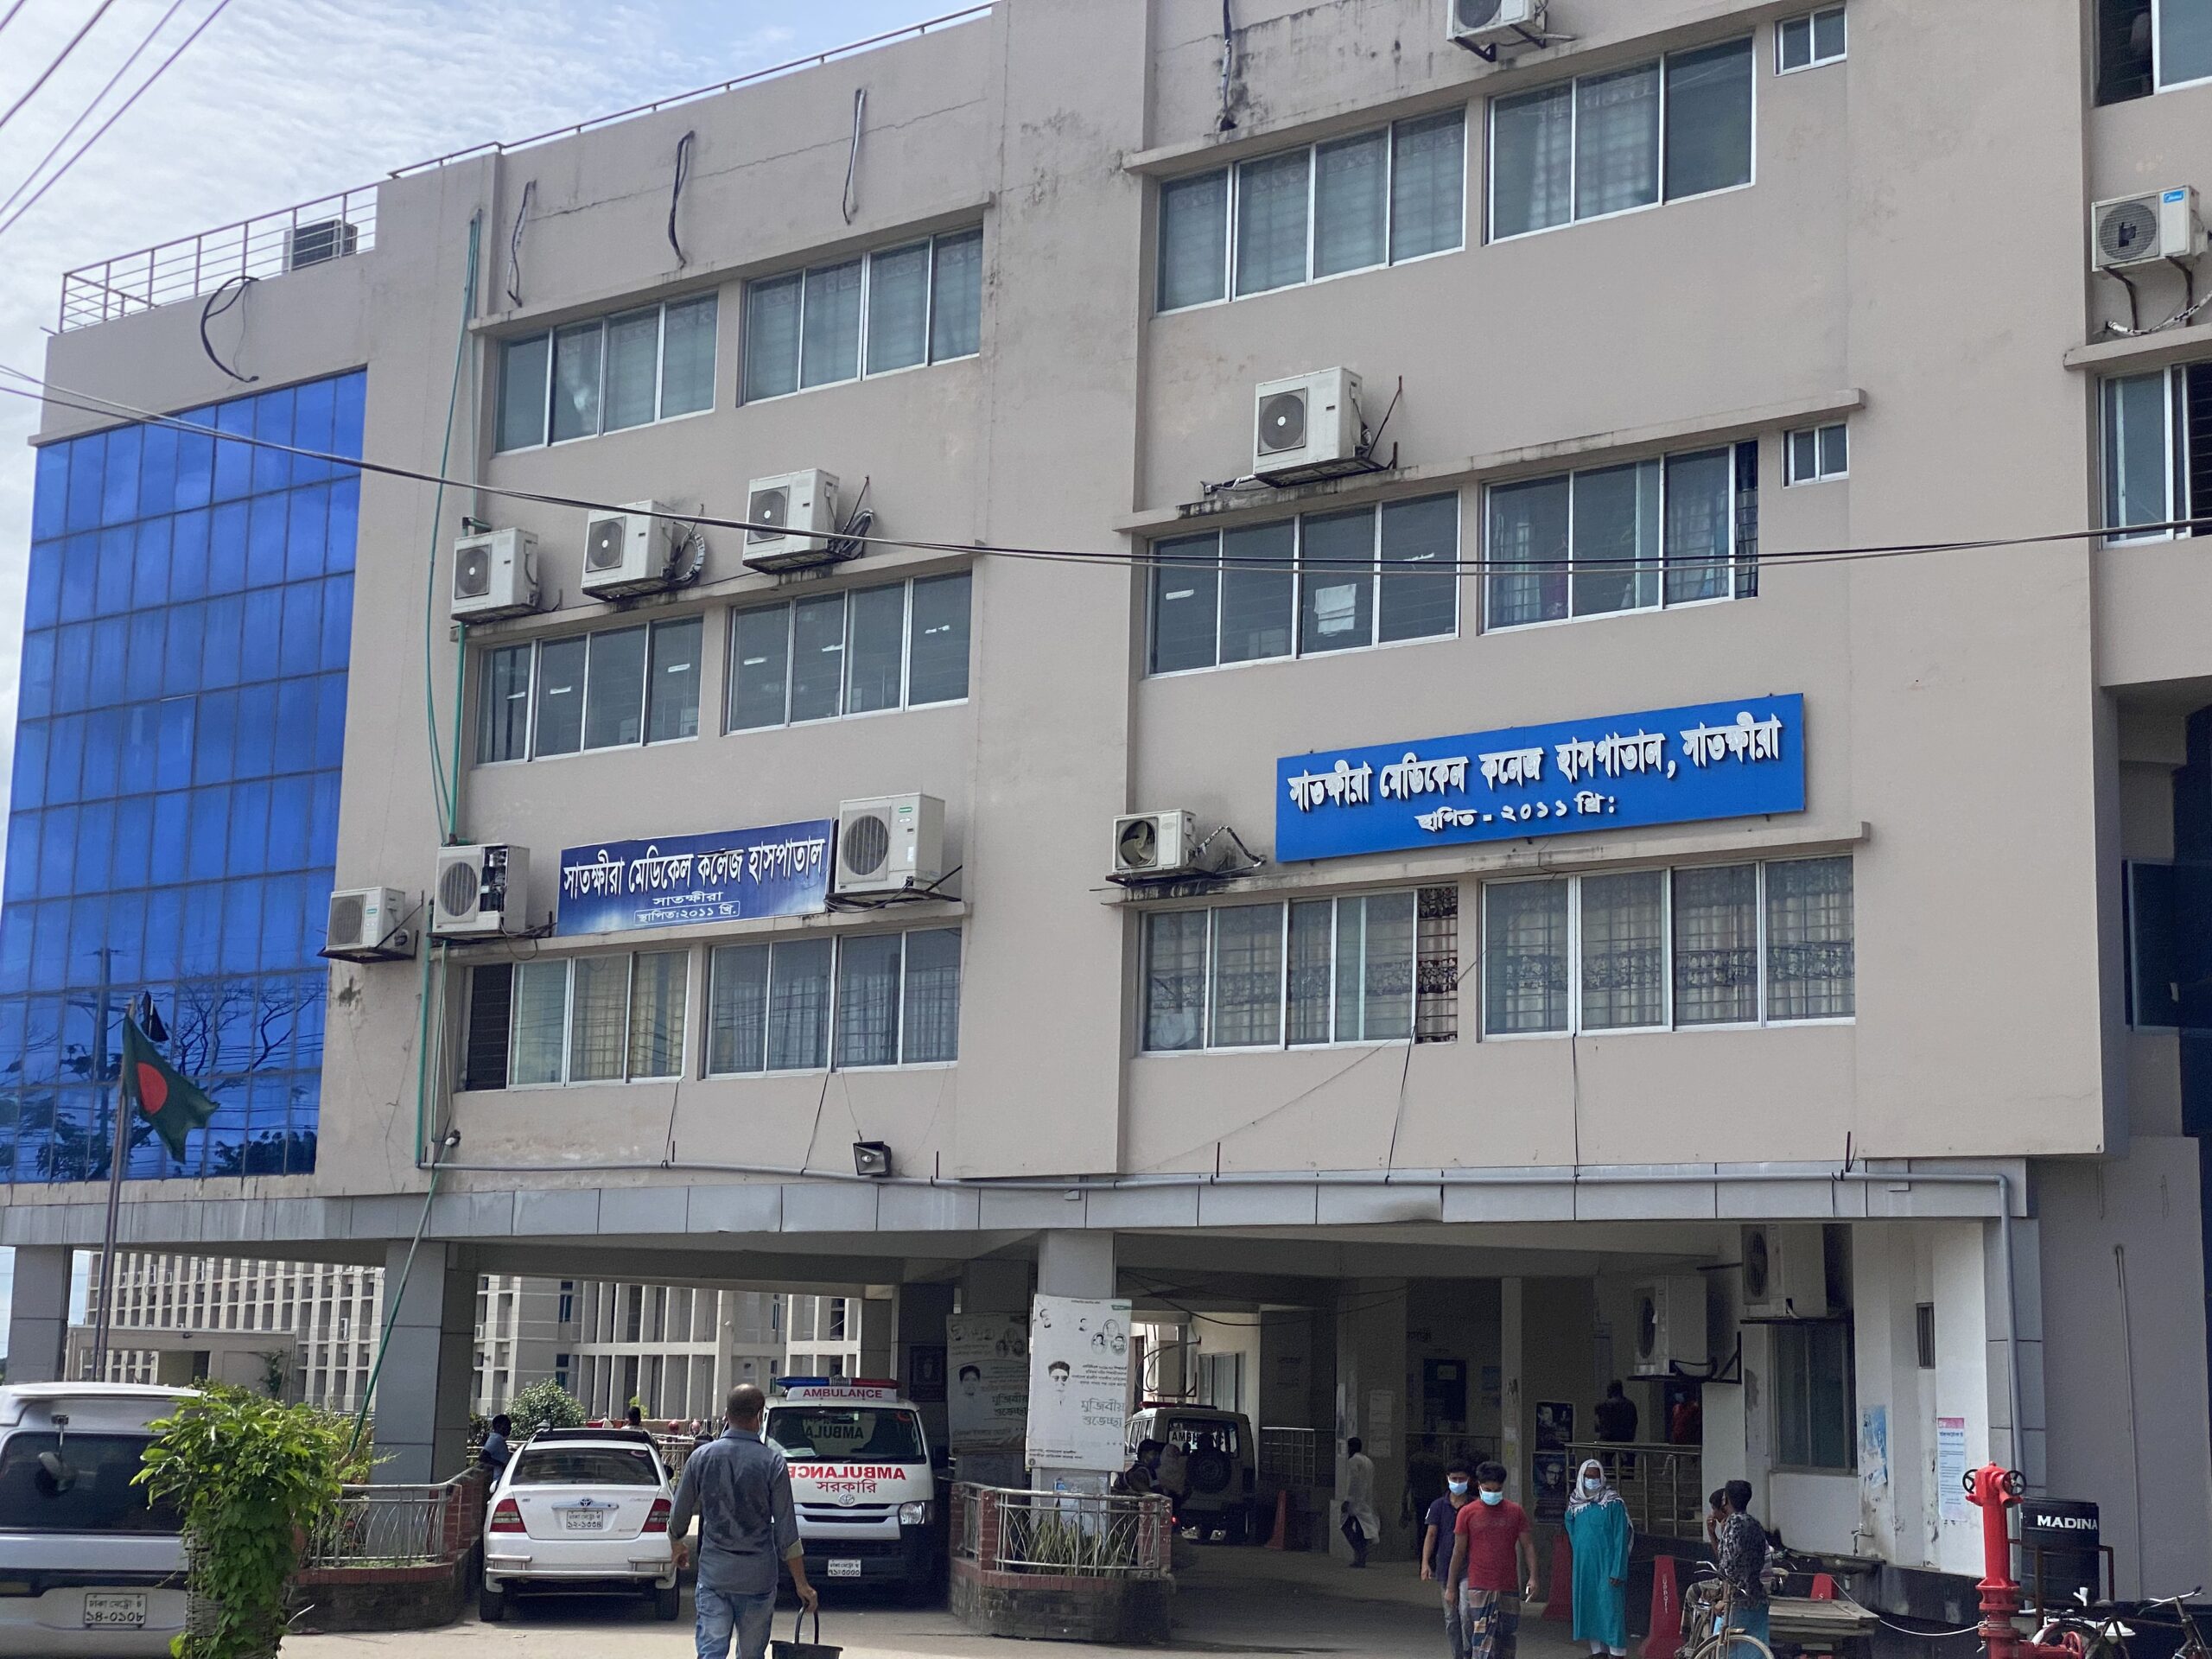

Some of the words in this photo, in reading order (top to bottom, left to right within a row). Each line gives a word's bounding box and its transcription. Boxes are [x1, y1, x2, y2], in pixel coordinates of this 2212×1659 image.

[1287, 759, 1372, 811] সাতক্ষীরা
[1380, 753, 1469, 799] মেডিকেল
[1478, 747, 1544, 791] কলেজ
[1555, 728, 1676, 783] হাসপাতাল,
[1680, 711, 1783, 766] সাতক্ষীরা
[1414, 806, 1477, 832] স্থাপিত
[1500, 799, 1567, 822] ২০১১
[563, 849, 626, 899] সাতক্ষীরা
[628, 844, 694, 893] মেডিকেল
[697, 848, 745, 887] কলেজ
[748, 835, 826, 886] হাসপাতাল
[652, 891, 724, 906] সাতক্ষীরা
[803, 1389, 882, 1398] AMBULANCE
[816, 1478, 878, 1494] সরকারি
[2037, 1515, 2098, 1530] MADINA
